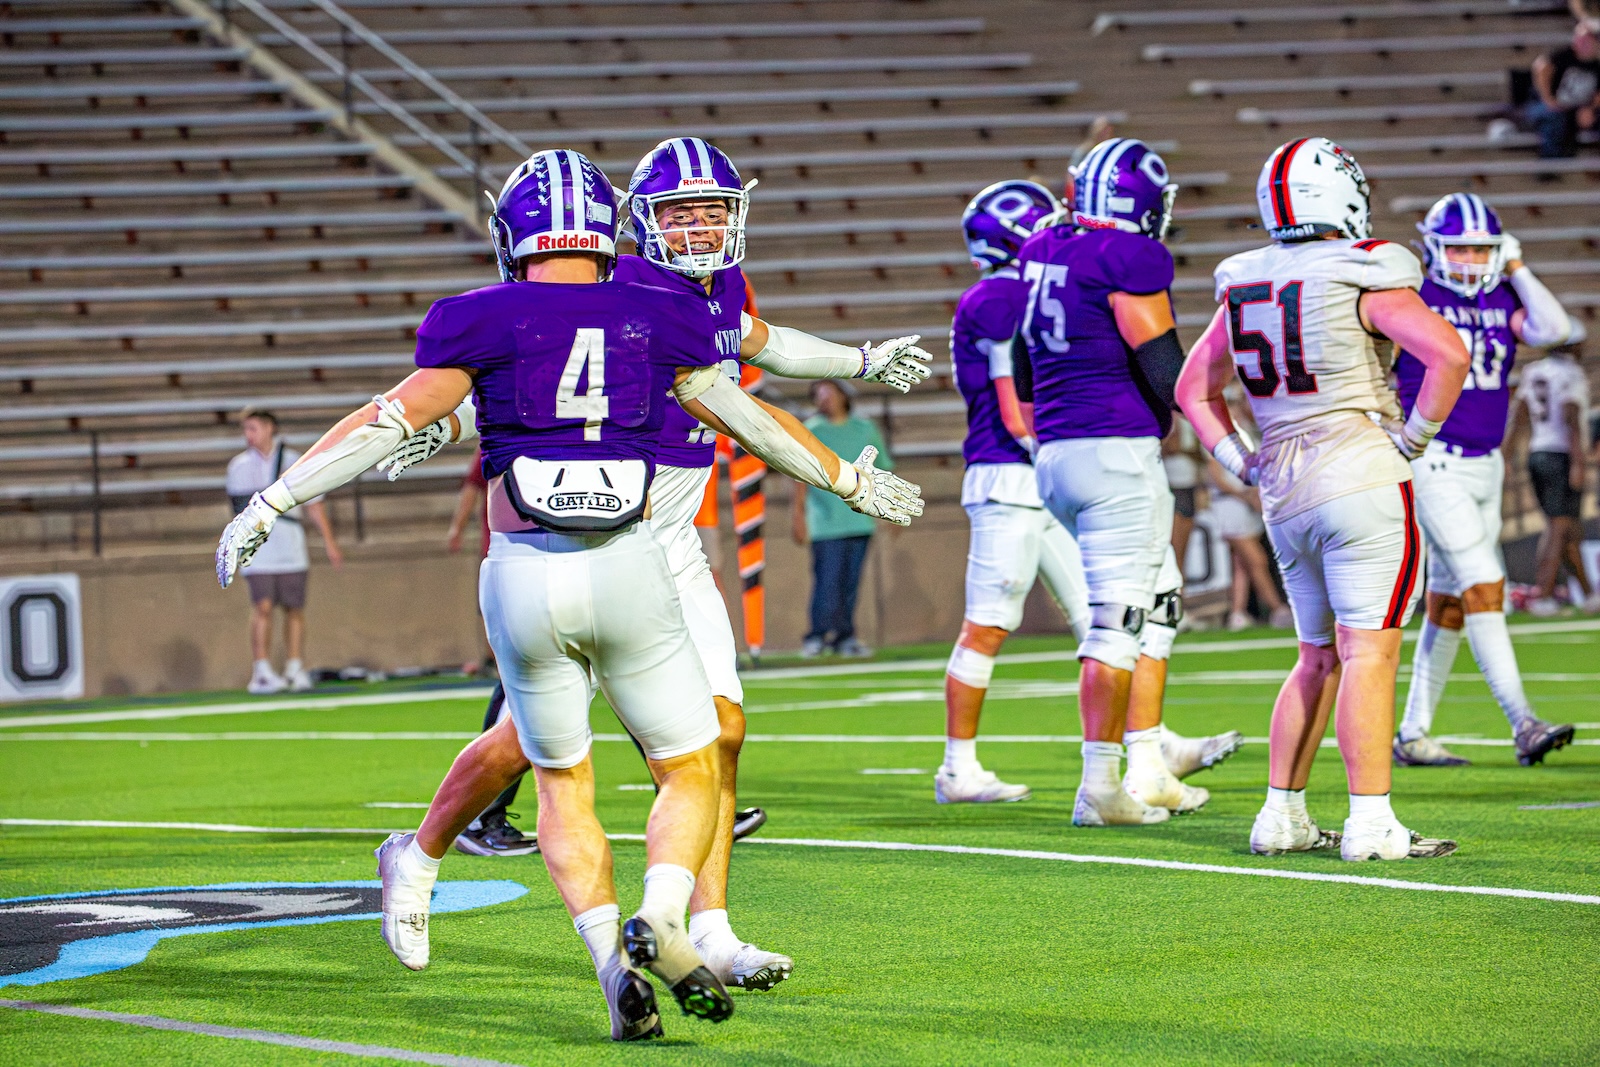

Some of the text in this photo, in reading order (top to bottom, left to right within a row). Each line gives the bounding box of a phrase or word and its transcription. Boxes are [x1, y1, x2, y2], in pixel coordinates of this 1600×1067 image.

[682, 178, 715, 187] Riddell
[537, 234, 599, 251] Riddell
[1021, 260, 1070, 353] 75
[1429, 305, 1507, 330] ANYON
[714, 328, 741, 356] NYON
[1225, 279, 1318, 398] 51
[555, 327, 609, 442] 4
[554, 495, 616, 509] BATTLE
